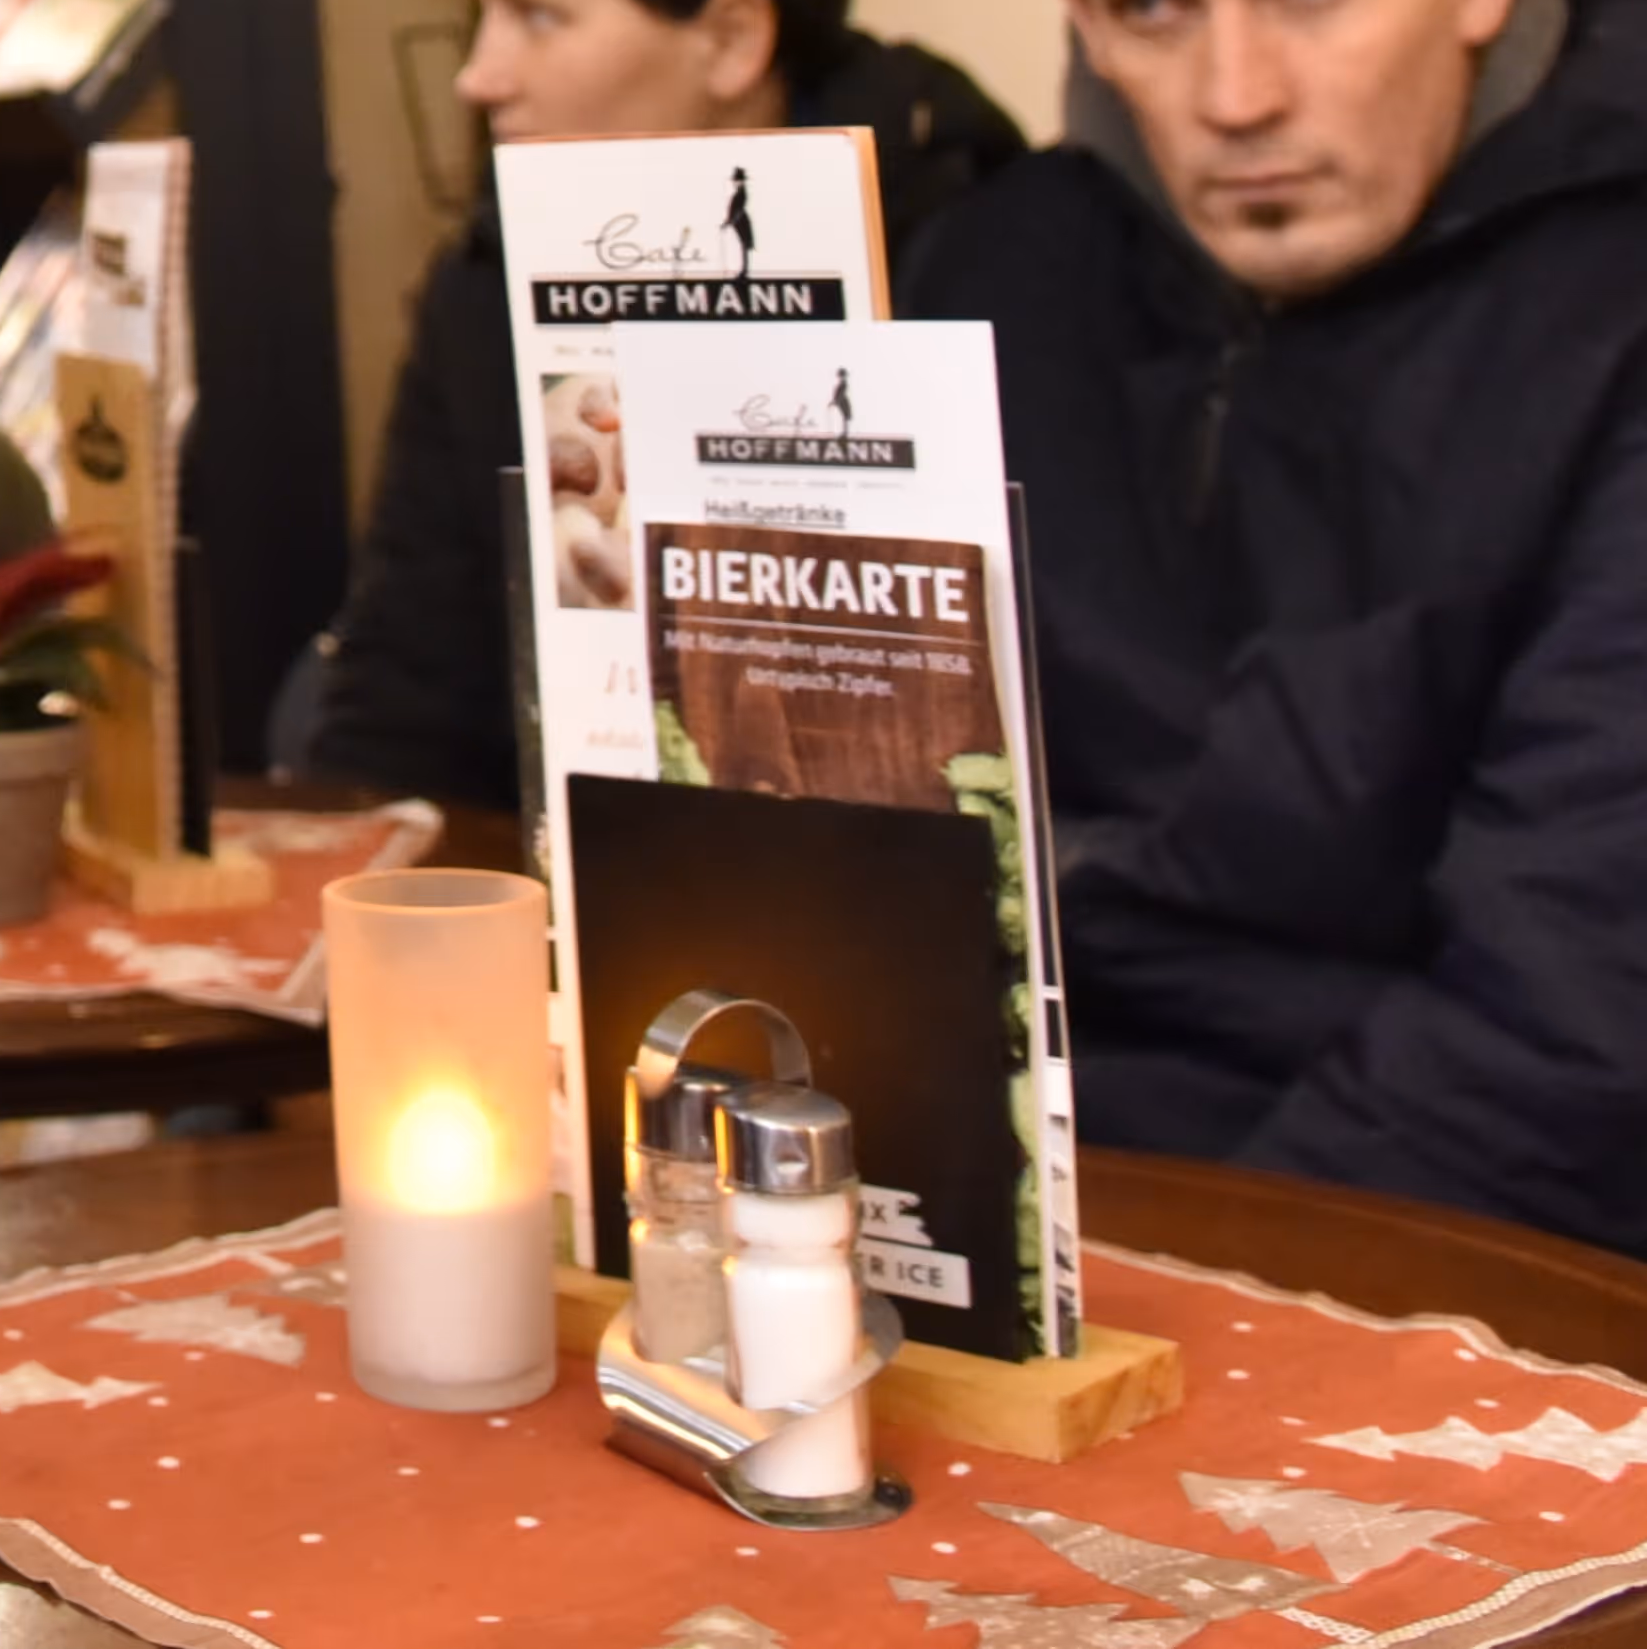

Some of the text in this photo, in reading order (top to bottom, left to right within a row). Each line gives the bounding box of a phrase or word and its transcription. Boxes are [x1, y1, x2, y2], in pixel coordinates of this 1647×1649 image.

[547, 283, 813, 316] HOFFMANN
[707, 438, 894, 463] HOFFMANN
[661, 547, 969, 623] BIERKARTE
[896, 1261, 945, 1288] ICE
